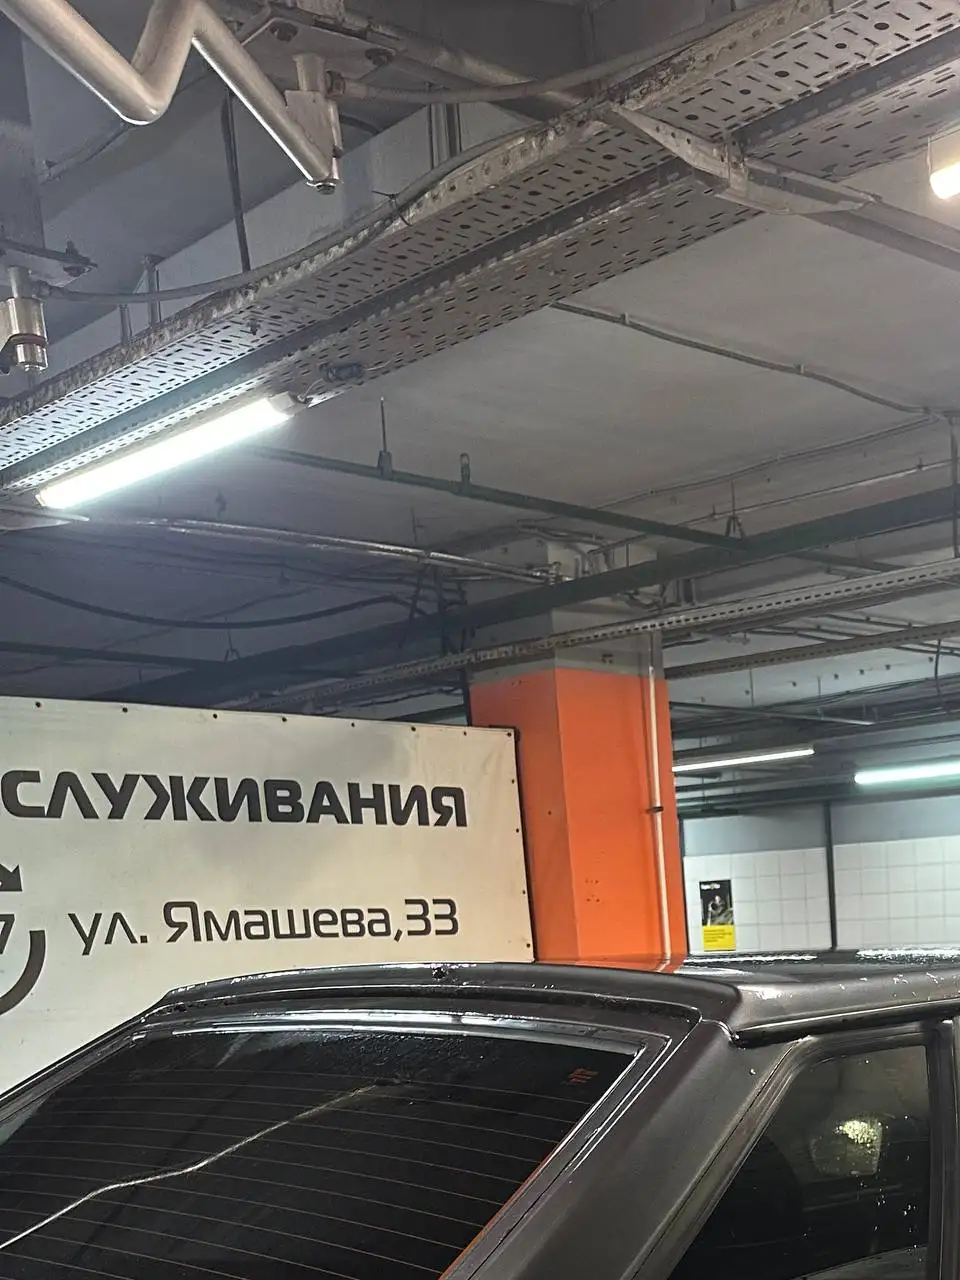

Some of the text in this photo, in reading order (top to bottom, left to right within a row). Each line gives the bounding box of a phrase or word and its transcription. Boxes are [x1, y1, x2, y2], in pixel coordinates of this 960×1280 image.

[0, 769, 468, 828] СЛУЖИВАНИЯ
[67, 898, 459, 956] ул. Ямашева,33
